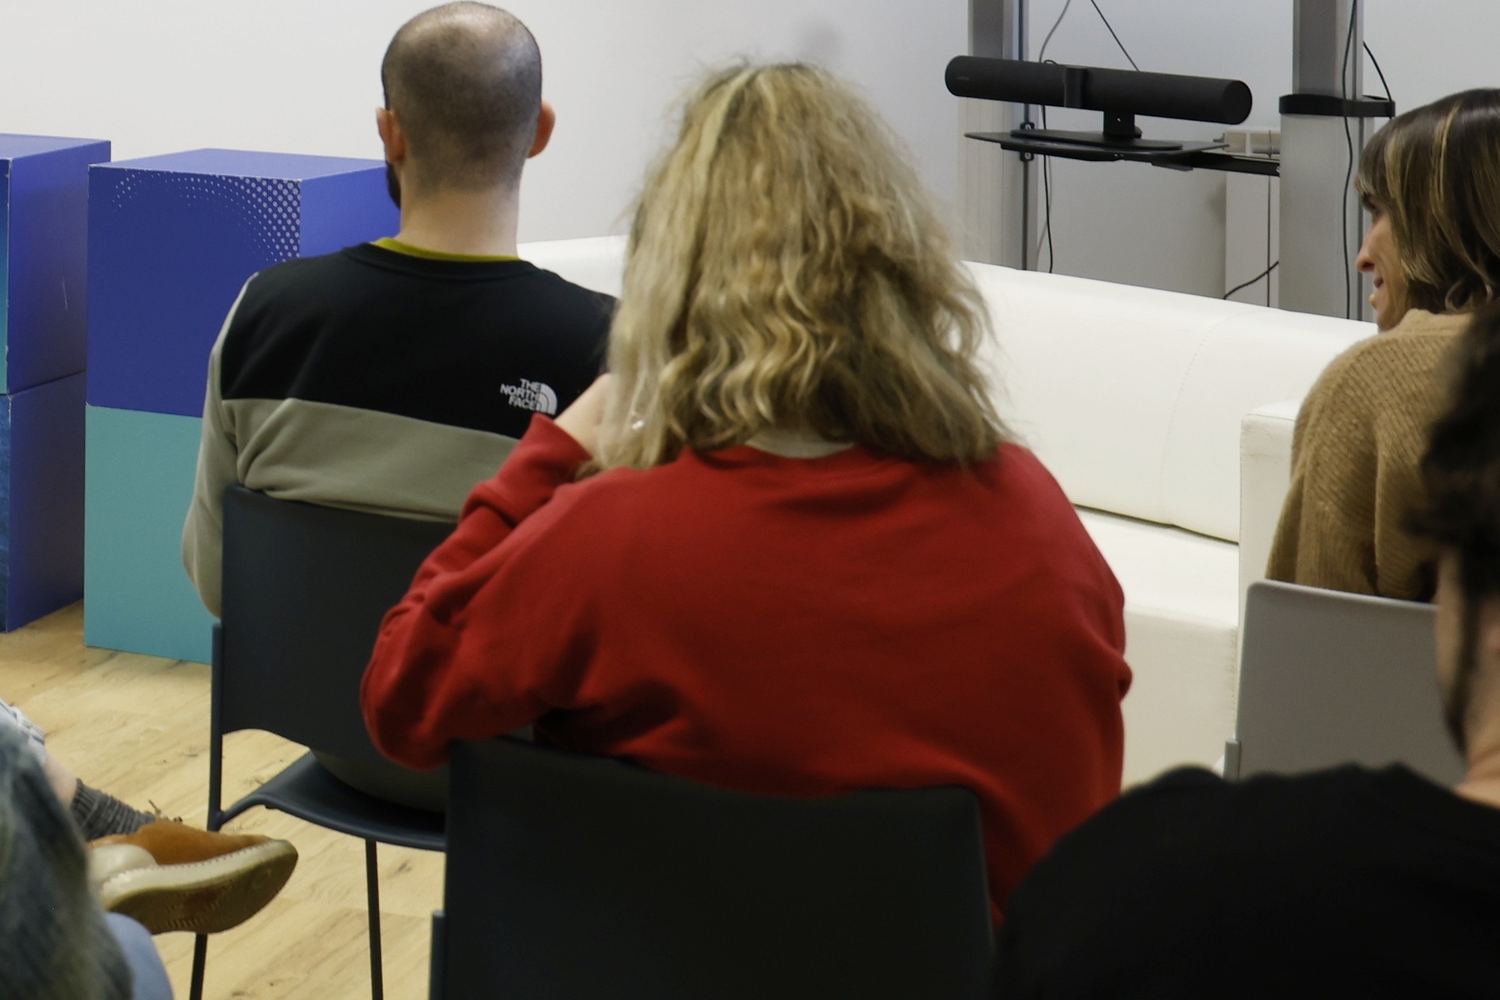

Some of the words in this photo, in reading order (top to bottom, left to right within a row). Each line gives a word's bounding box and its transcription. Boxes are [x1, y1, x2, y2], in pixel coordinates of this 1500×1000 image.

[500, 384, 541, 401] NORTH
[520, 378, 541, 391] THE
[508, 395, 537, 411] FACE
